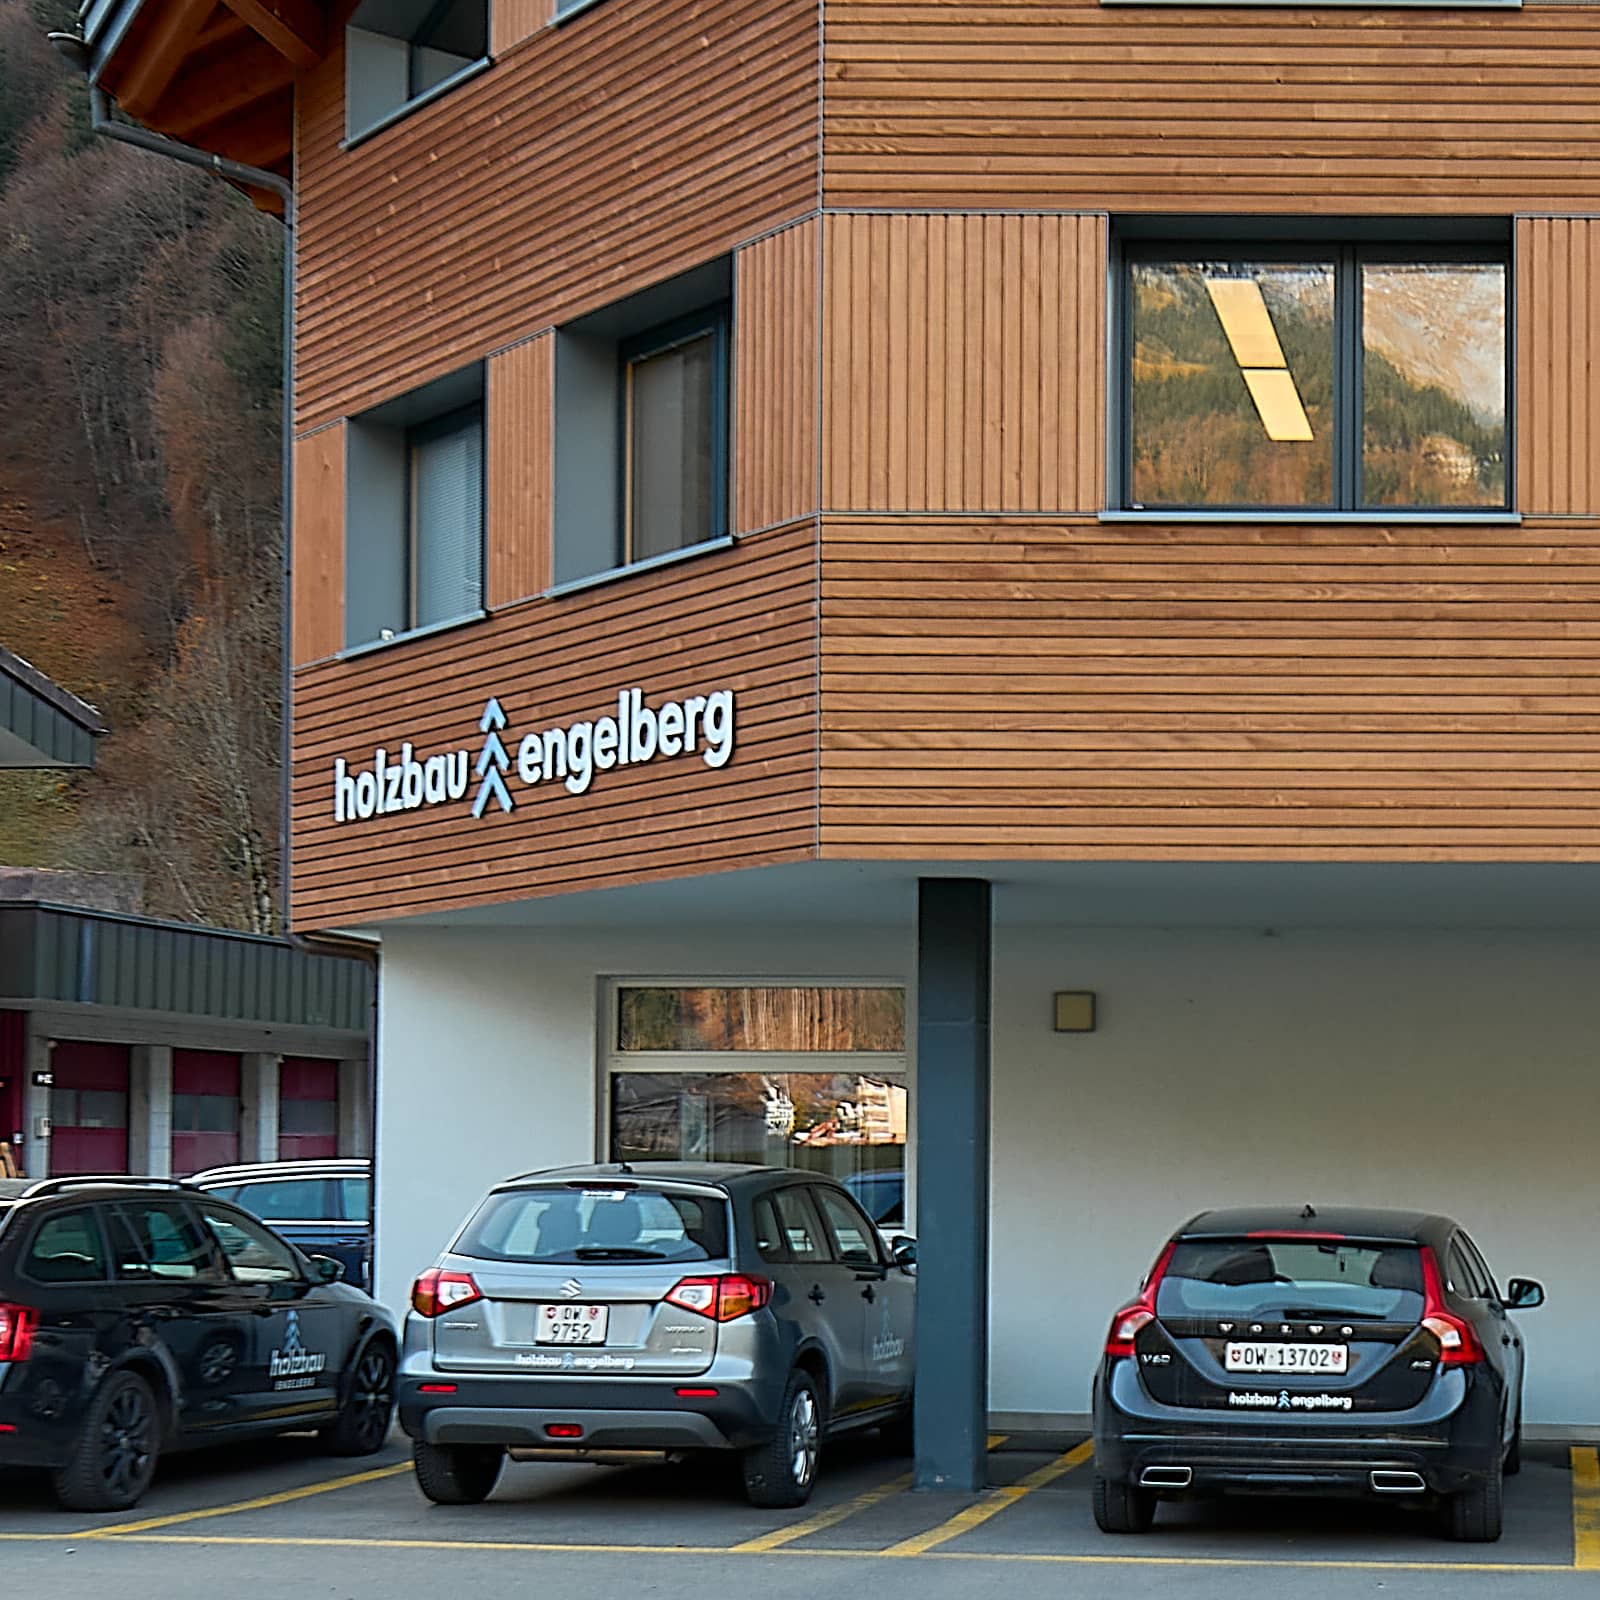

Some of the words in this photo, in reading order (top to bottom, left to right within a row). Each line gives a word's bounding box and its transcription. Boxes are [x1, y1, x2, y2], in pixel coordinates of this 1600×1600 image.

[333, 742, 469, 822] holzbau
[517, 687, 734, 794] engelberg
[552, 1323, 592, 1340] 9752
[1219, 1323, 1353, 1336] VOLVO
[270, 1348, 325, 1377] holzbau
[514, 1353, 561, 1366] holzbau
[575, 1355, 635, 1369] engelberg
[1229, 1392, 1277, 1406] holzbau
[1291, 1394, 1352, 1410] engelberg
